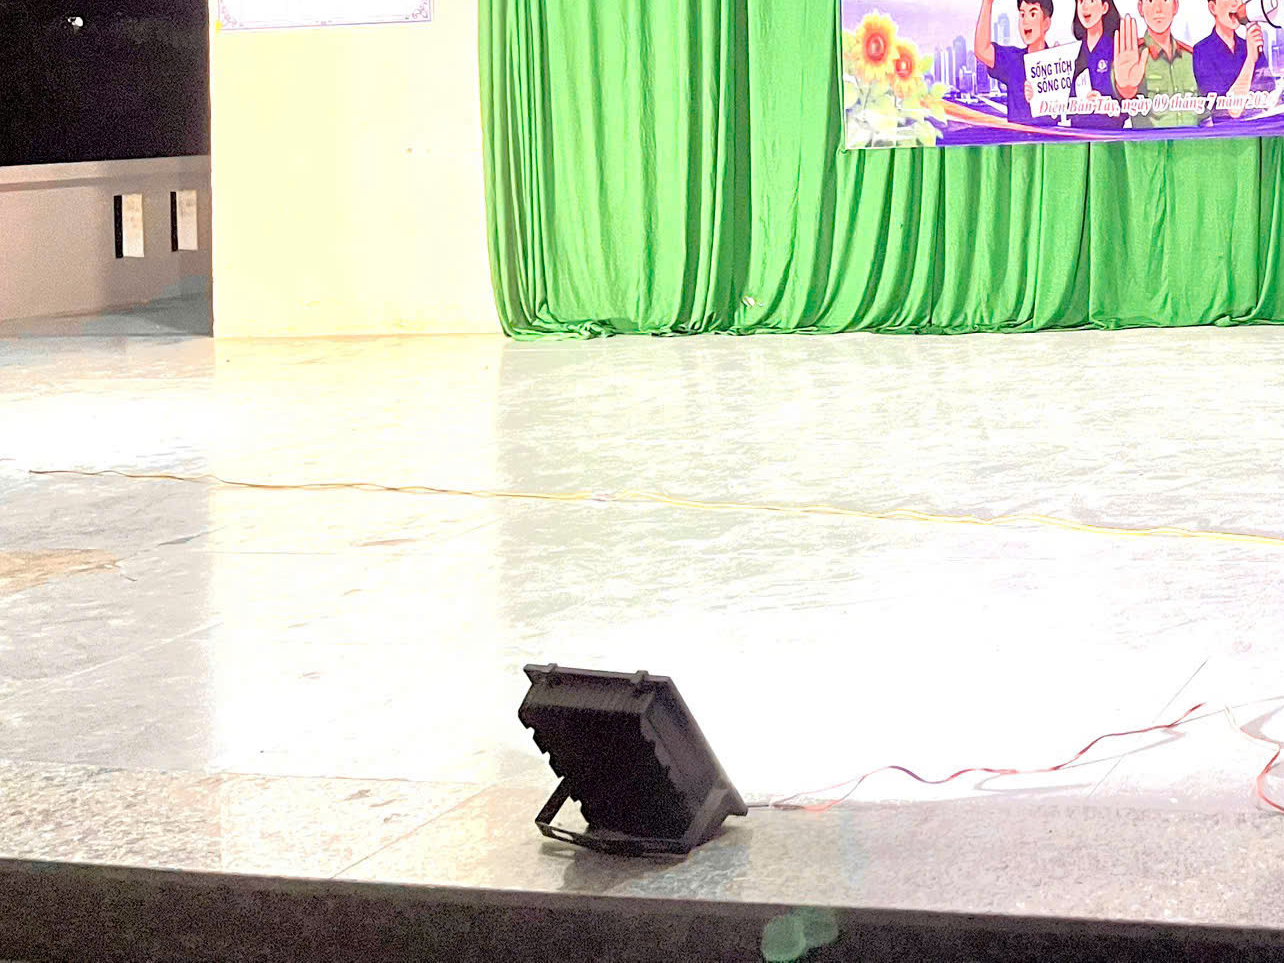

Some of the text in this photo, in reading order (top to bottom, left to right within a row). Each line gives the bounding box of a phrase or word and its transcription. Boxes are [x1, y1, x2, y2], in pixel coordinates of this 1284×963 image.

[1031, 58, 1072, 78] SỐNG TÍCH
[1037, 77, 1059, 94] SỐNG
[1207, 93, 1217, 109] 7
